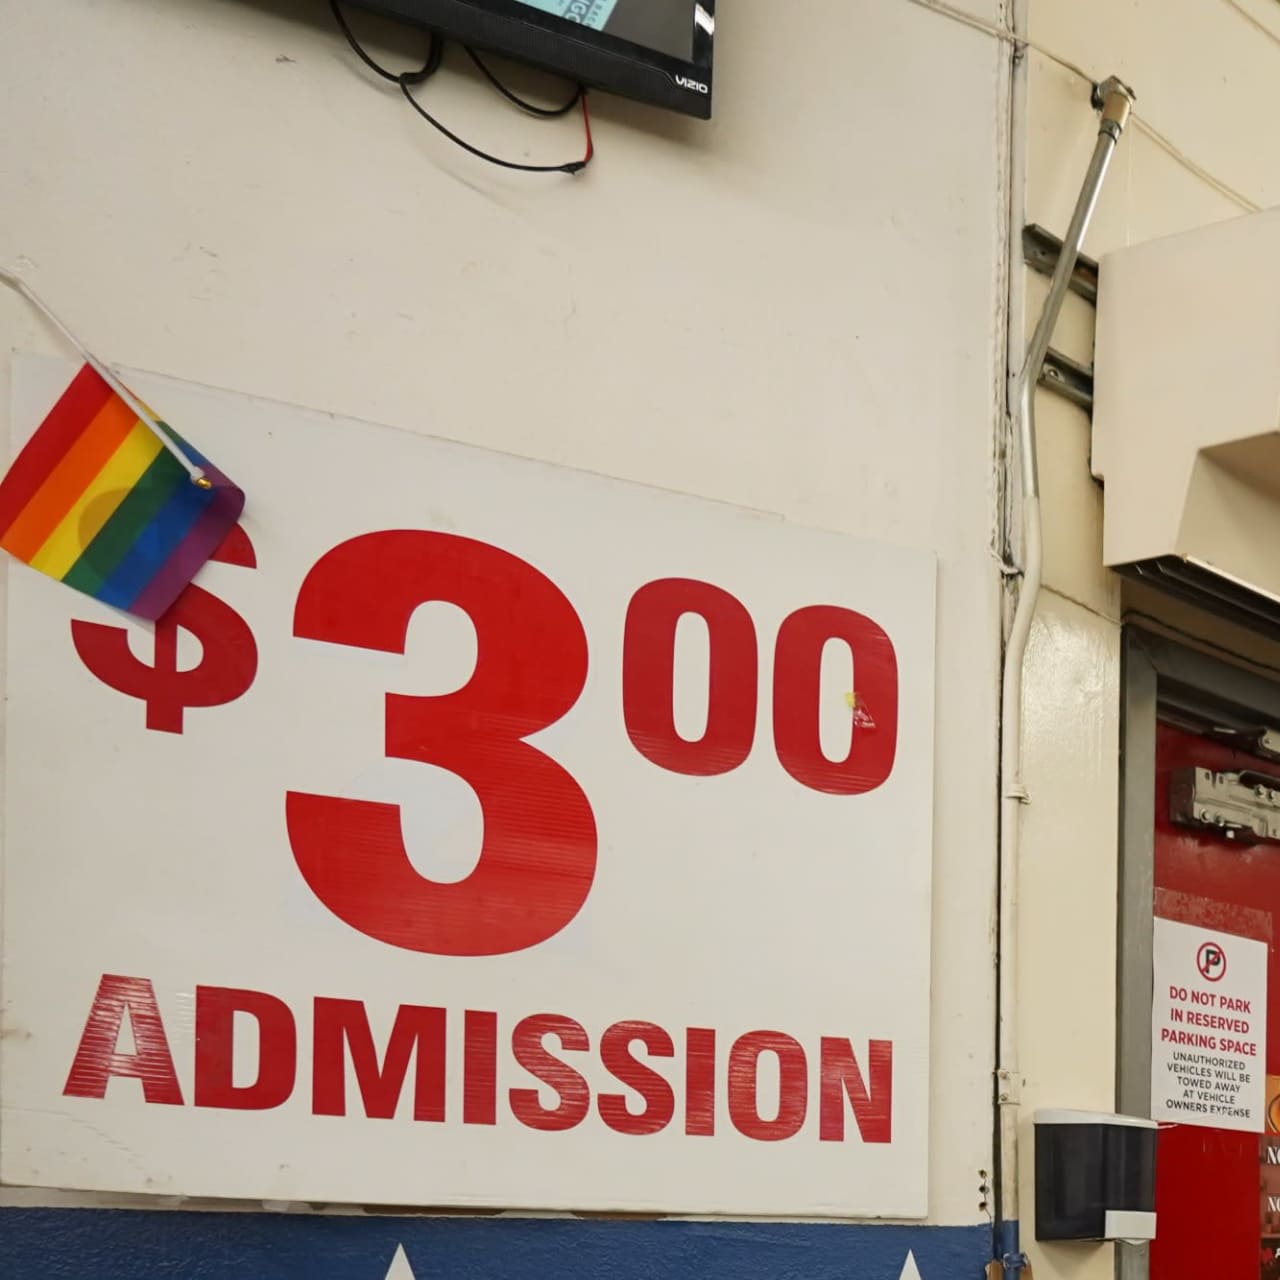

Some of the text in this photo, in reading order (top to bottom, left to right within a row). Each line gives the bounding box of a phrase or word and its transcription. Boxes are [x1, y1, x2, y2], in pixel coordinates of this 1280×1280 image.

[675, 75, 708, 94] VIZIO
[1170, 986, 1250, 1013] DO NOT PARK
[1170, 1008, 1249, 1033] IN RESERVED
[1161, 1028, 1256, 1056] PARKING SPACE
[63, 973, 893, 1143] ADMISSION
[1173, 1052, 1245, 1070] UNAUTHORIZED
[1167, 1063, 1250, 1083] VEHICLES WILL BE
[1177, 1076, 1240, 1092] TOWED AWAY
[1183, 1090, 1235, 1104] AT VEHICLE
[1166, 1100, 1251, 1118] OWNERS EXPENSE
